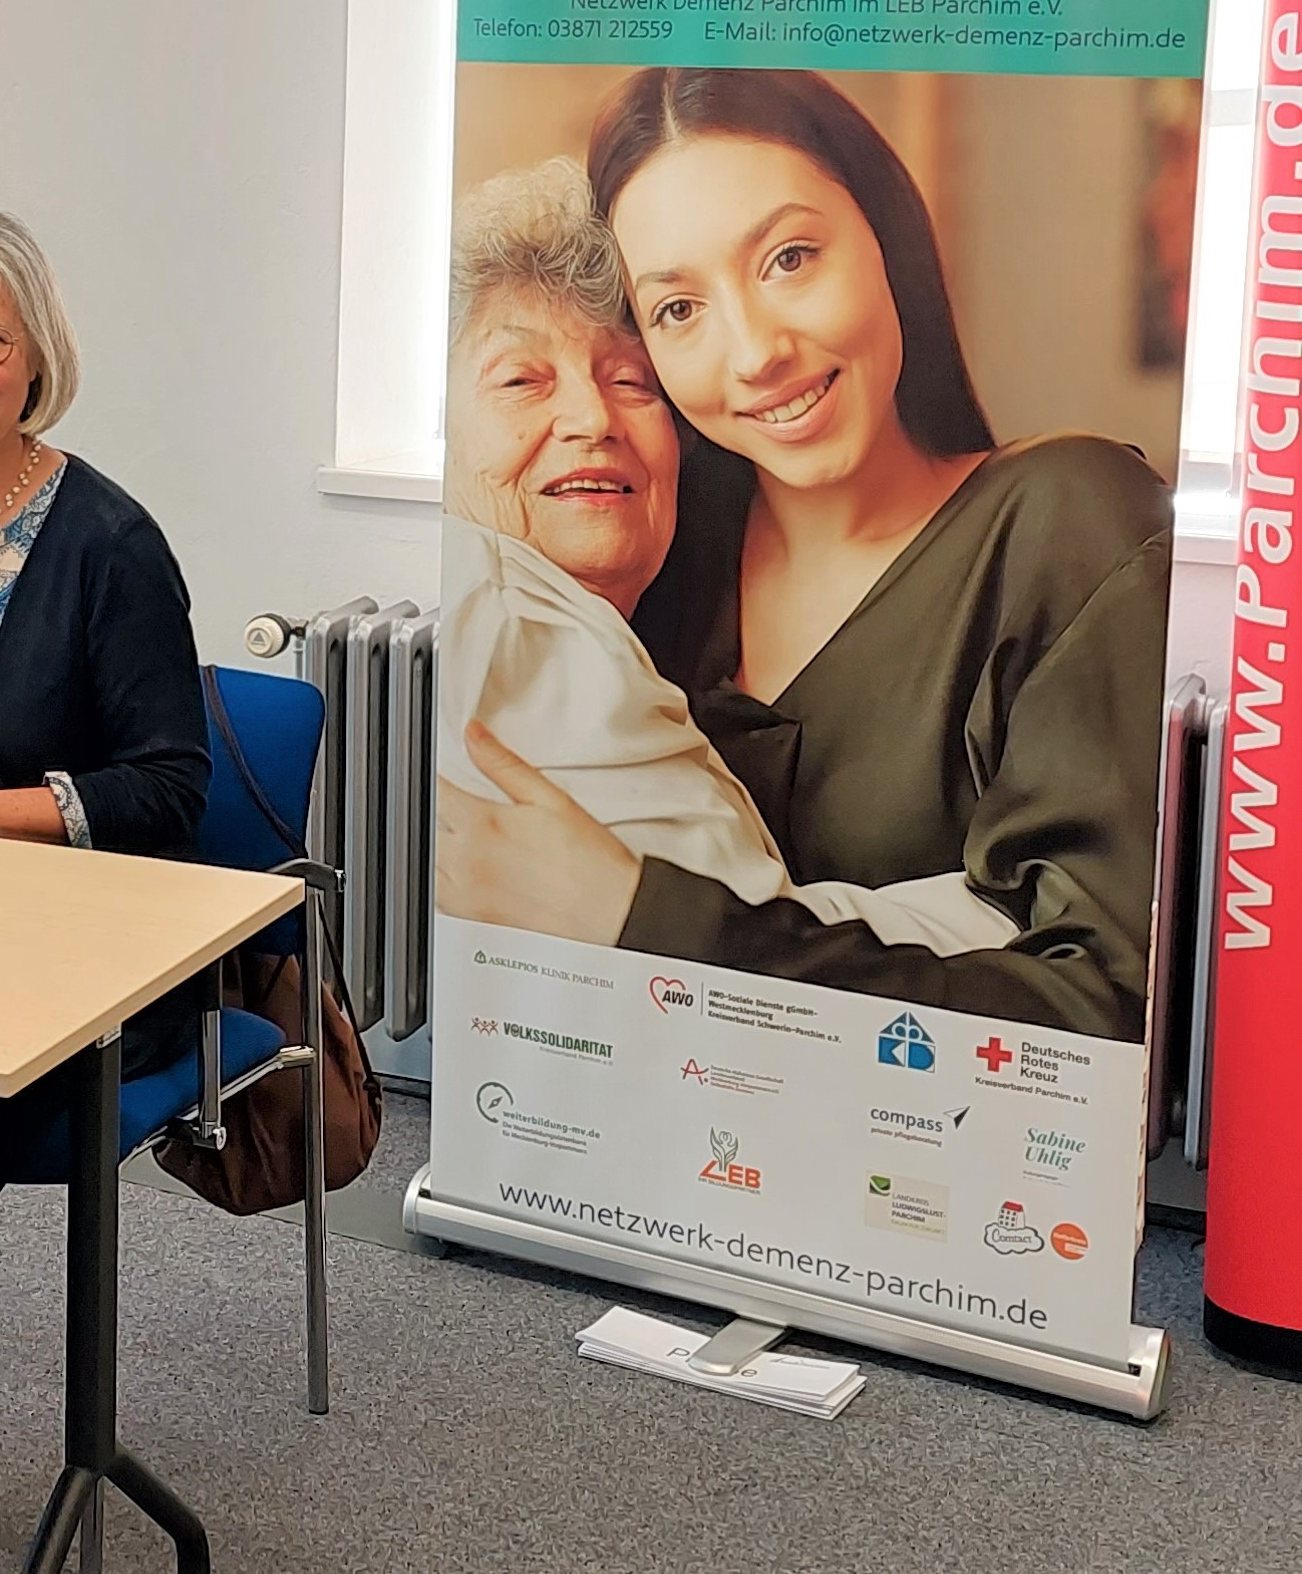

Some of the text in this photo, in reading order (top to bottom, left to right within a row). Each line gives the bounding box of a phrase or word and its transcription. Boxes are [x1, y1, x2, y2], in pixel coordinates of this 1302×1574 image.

[474, 17, 1186, 51] Telefon: 03871 212559 E-Mail: info@netzwerk-demenz-parchim.de
[488, 957, 614, 989] ASKLEPIOS KLINIK PARCHIM
[662, 989, 694, 1007] AWO
[708, 999, 774, 1020] Westmecklenburg
[755, 998, 784, 1011] Dienste
[708, 1010, 755, 1027] Kreisverband
[1020, 1054, 1059, 1072] Rotes
[1021, 1041, 1091, 1066] Deutsches
[1020, 1066, 1059, 1084] Kreuz
[975, 1076, 1034, 1094] Kreisverband
[1035, 1087, 1072, 1102] Parchim
[502, 1109, 601, 1140] weiterbildung-mv.de
[870, 1107, 944, 1133] compass
[1024, 1126, 1086, 1153] Sabine
[1025, 1145, 1073, 1171] Uhlig
[700, 1159, 761, 1189] LEB
[499, 1182, 1048, 1330] www.netzwerk-demenz-parchim.de
